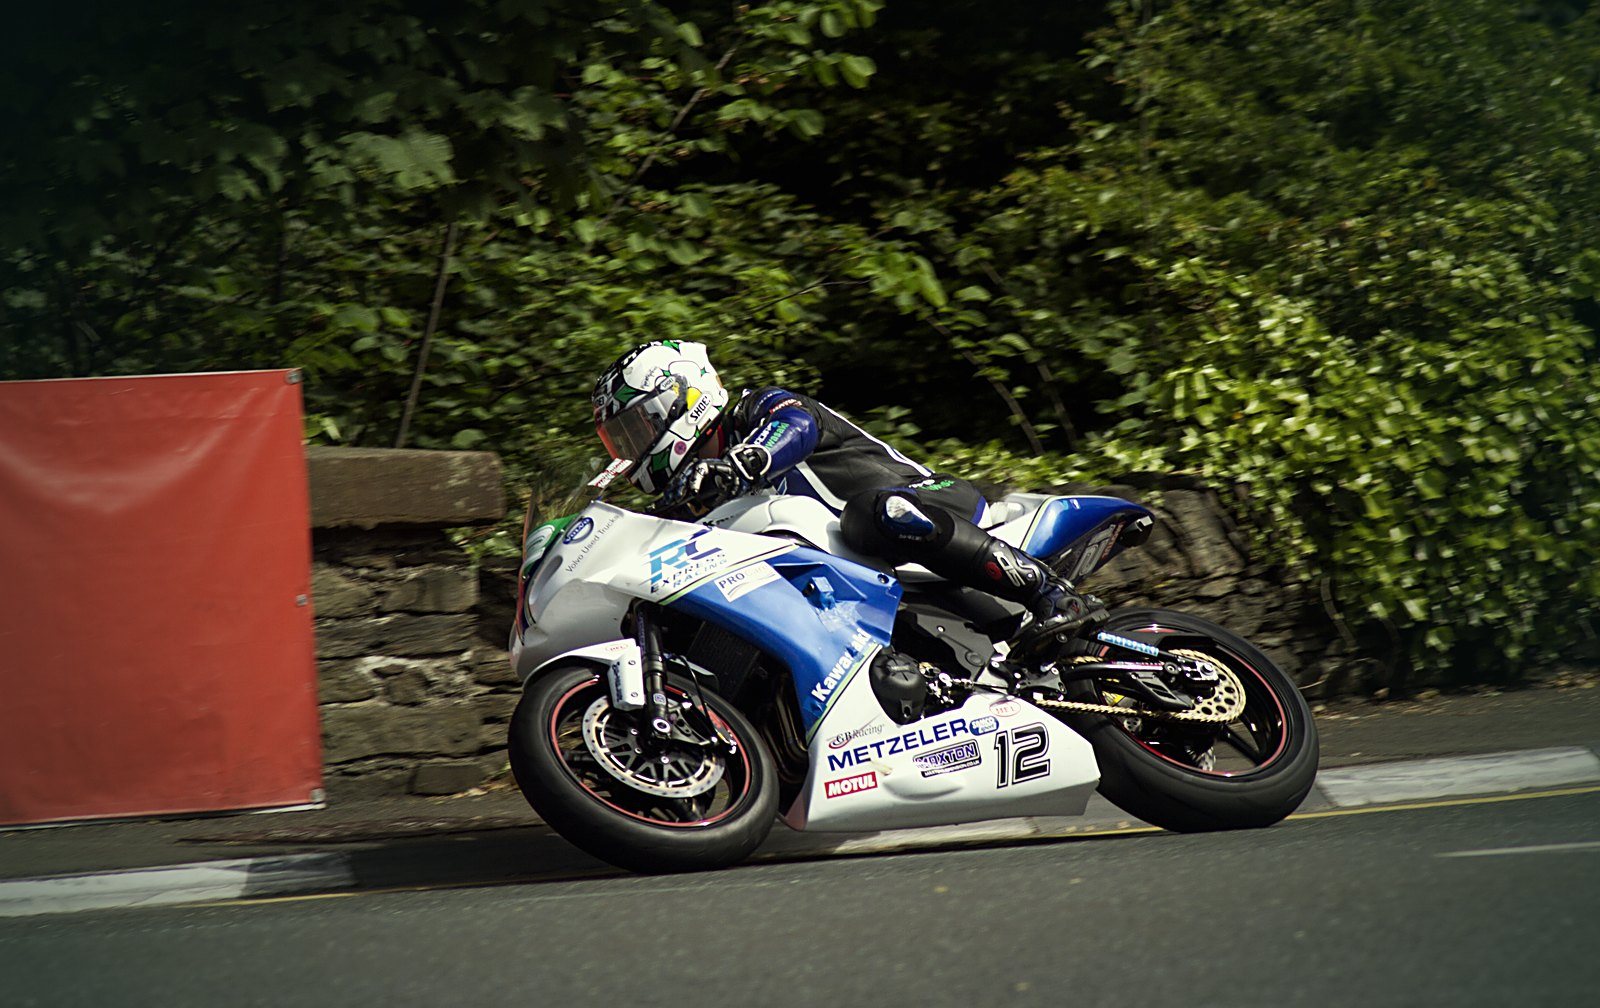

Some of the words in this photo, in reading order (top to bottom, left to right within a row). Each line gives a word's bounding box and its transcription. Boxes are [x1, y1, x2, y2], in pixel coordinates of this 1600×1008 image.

[689, 395, 711, 421] SHOEI
[564, 517, 591, 544] VOLVO
[565, 554, 584, 573] Volvo
[581, 535, 601, 554] Used
[599, 515, 620, 535] Trucks
[827, 717, 969, 772] METZELER
[993, 721, 1051, 789] 12
[828, 774, 875, 797] MOTUL
